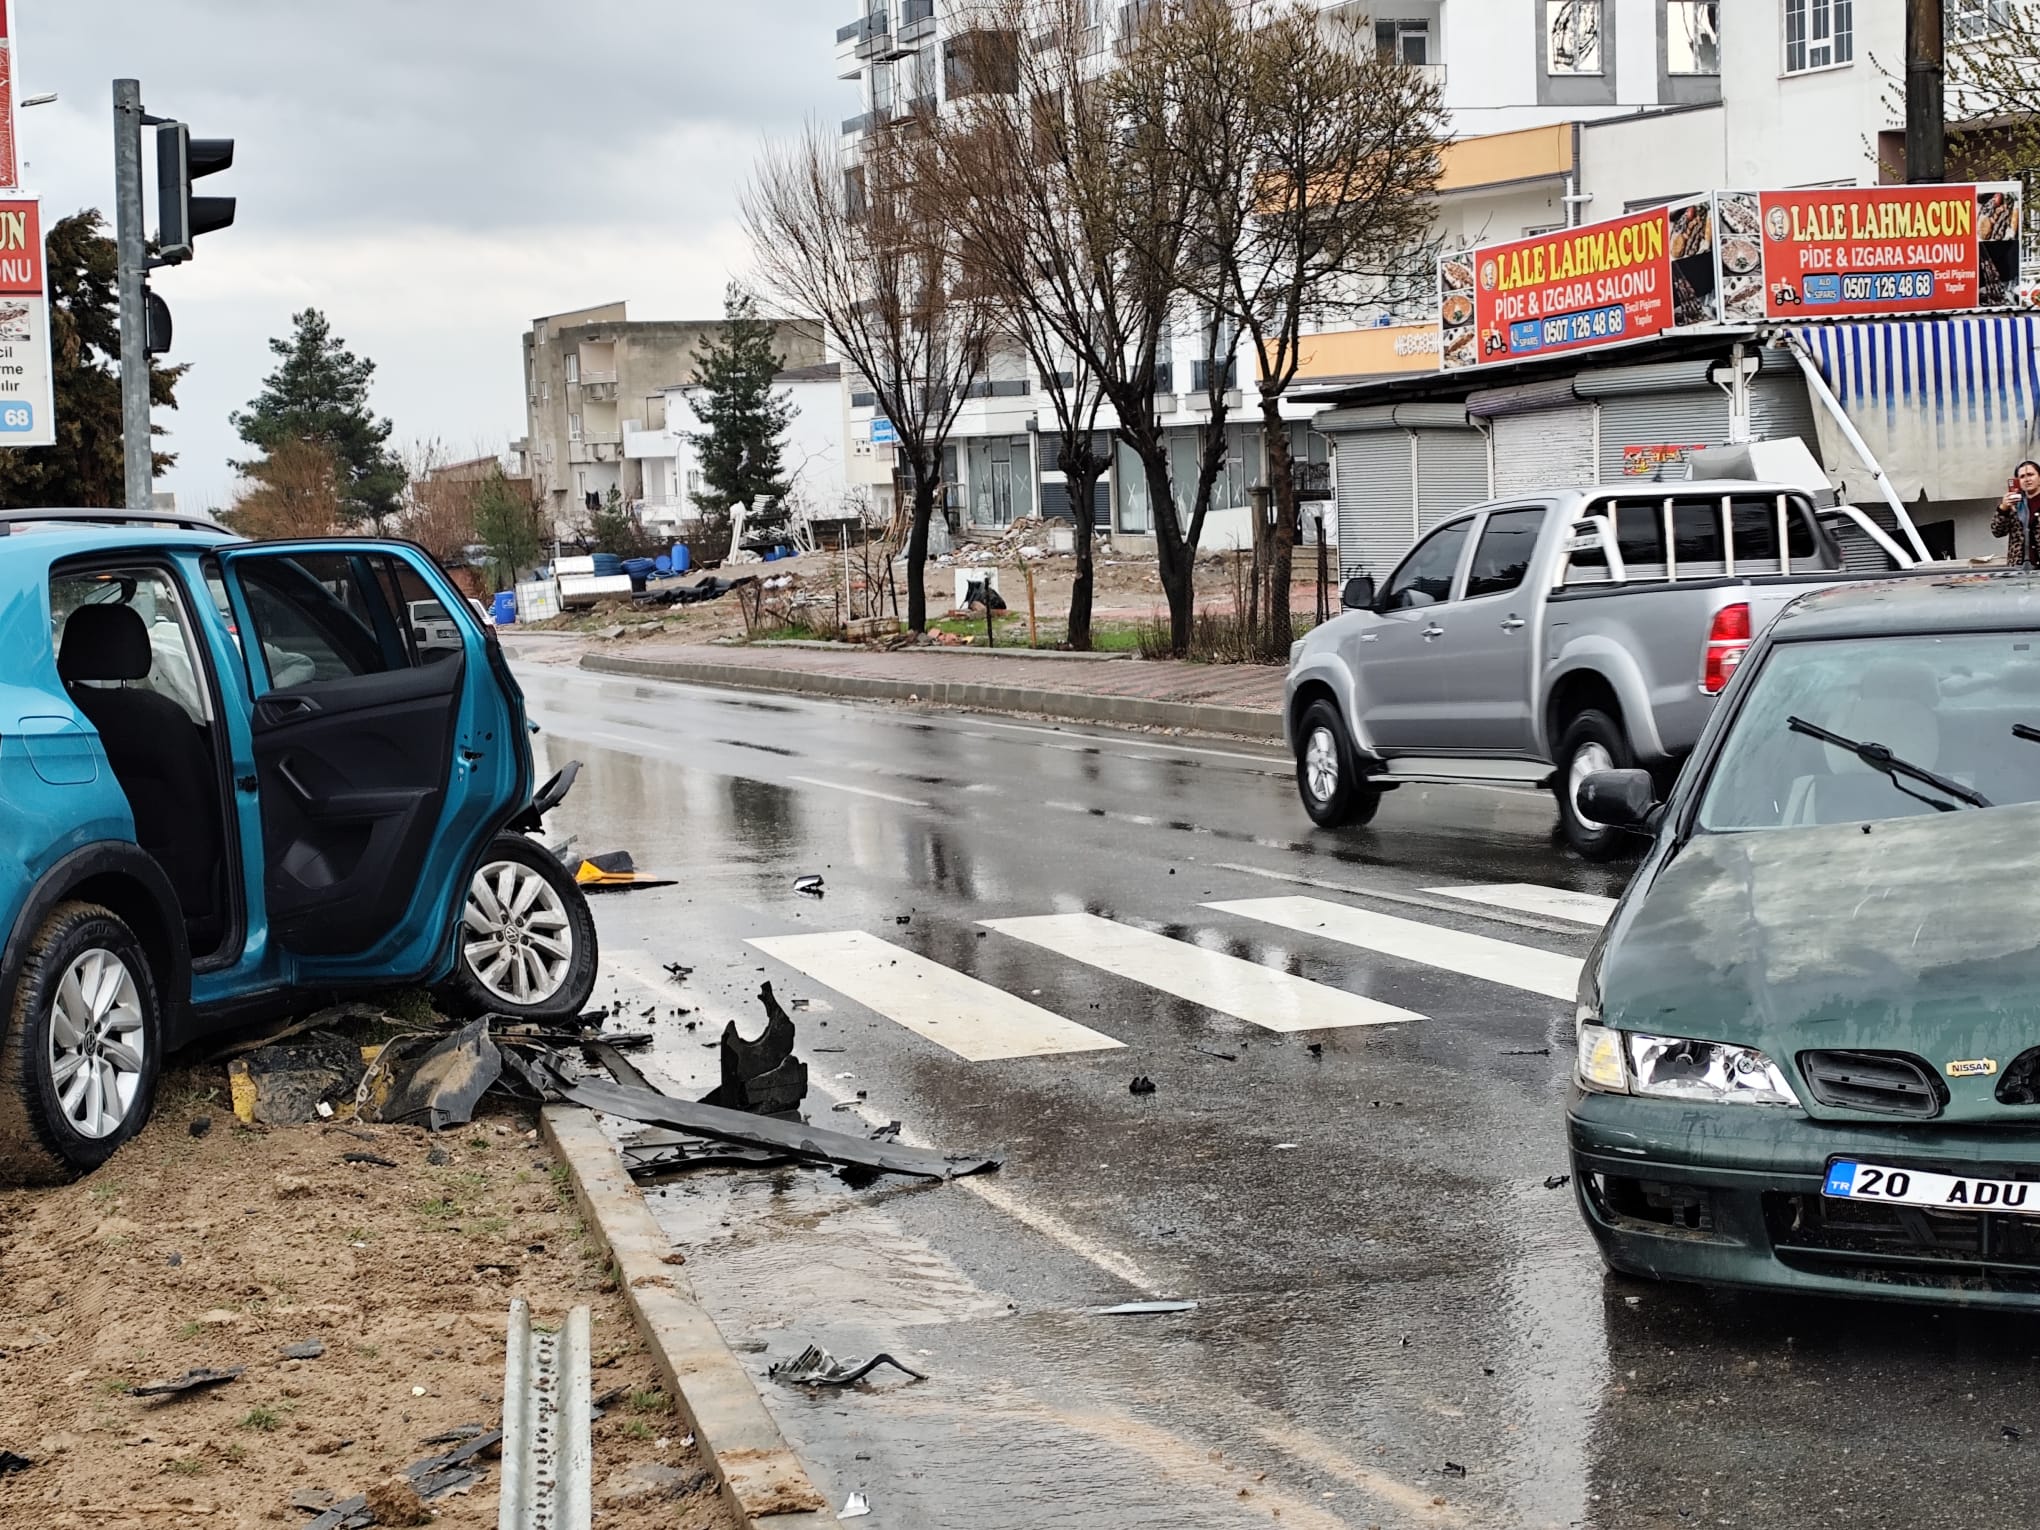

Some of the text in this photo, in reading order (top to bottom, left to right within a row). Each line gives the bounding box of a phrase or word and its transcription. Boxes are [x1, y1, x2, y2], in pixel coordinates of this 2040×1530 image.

[1792, 200, 1971, 241] LALE LAHMACUN
[1497, 218, 1663, 291] LALE LAHMACUN
[1799, 243, 1965, 269] PİDE & IZGARA SALONU
[1495, 267, 1657, 320] PİDE & IZGARA SALONU
[1842, 271, 1932, 299] 0507 126 48 68
[1543, 308, 1624, 345] 0507 126 48 68
[4, 408, 30, 427] 68
[1951, 1063, 1991, 1073] NISSAN
[1831, 1181, 1850, 1191] TR
[1856, 1168, 2029, 1207] 20 ADU
